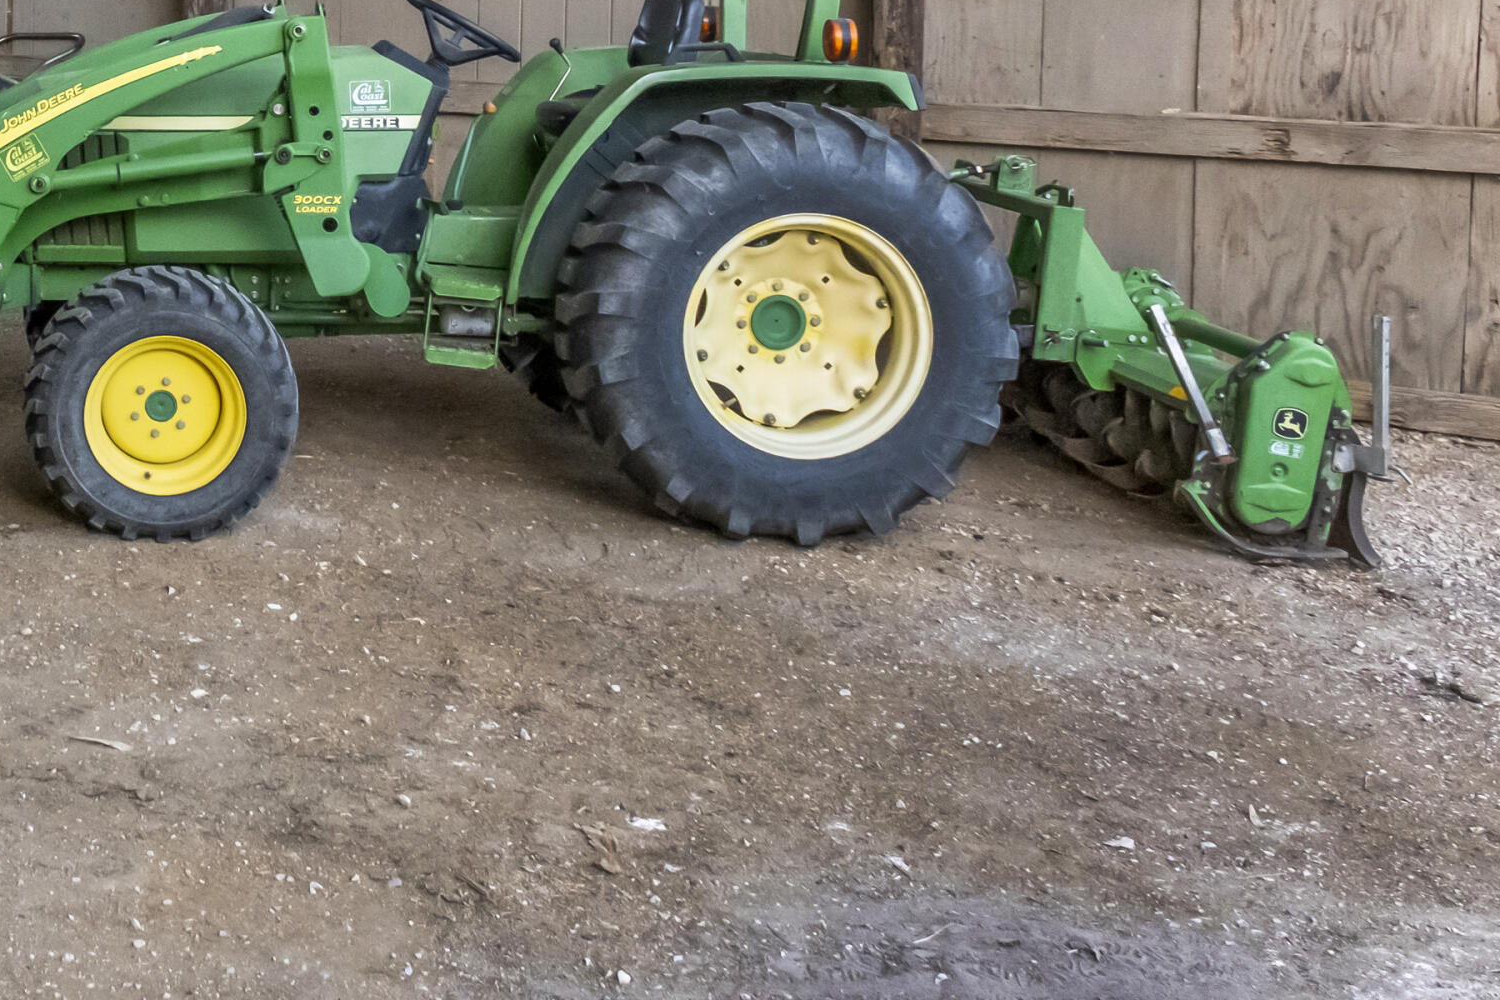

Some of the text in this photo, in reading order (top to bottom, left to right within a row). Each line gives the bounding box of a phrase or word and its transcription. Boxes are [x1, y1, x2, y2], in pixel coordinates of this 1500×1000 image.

[1, 82, 85, 134] JOHN DEERE
[293, 194, 343, 205] 300CX
[295, 205, 339, 214] LOADER
